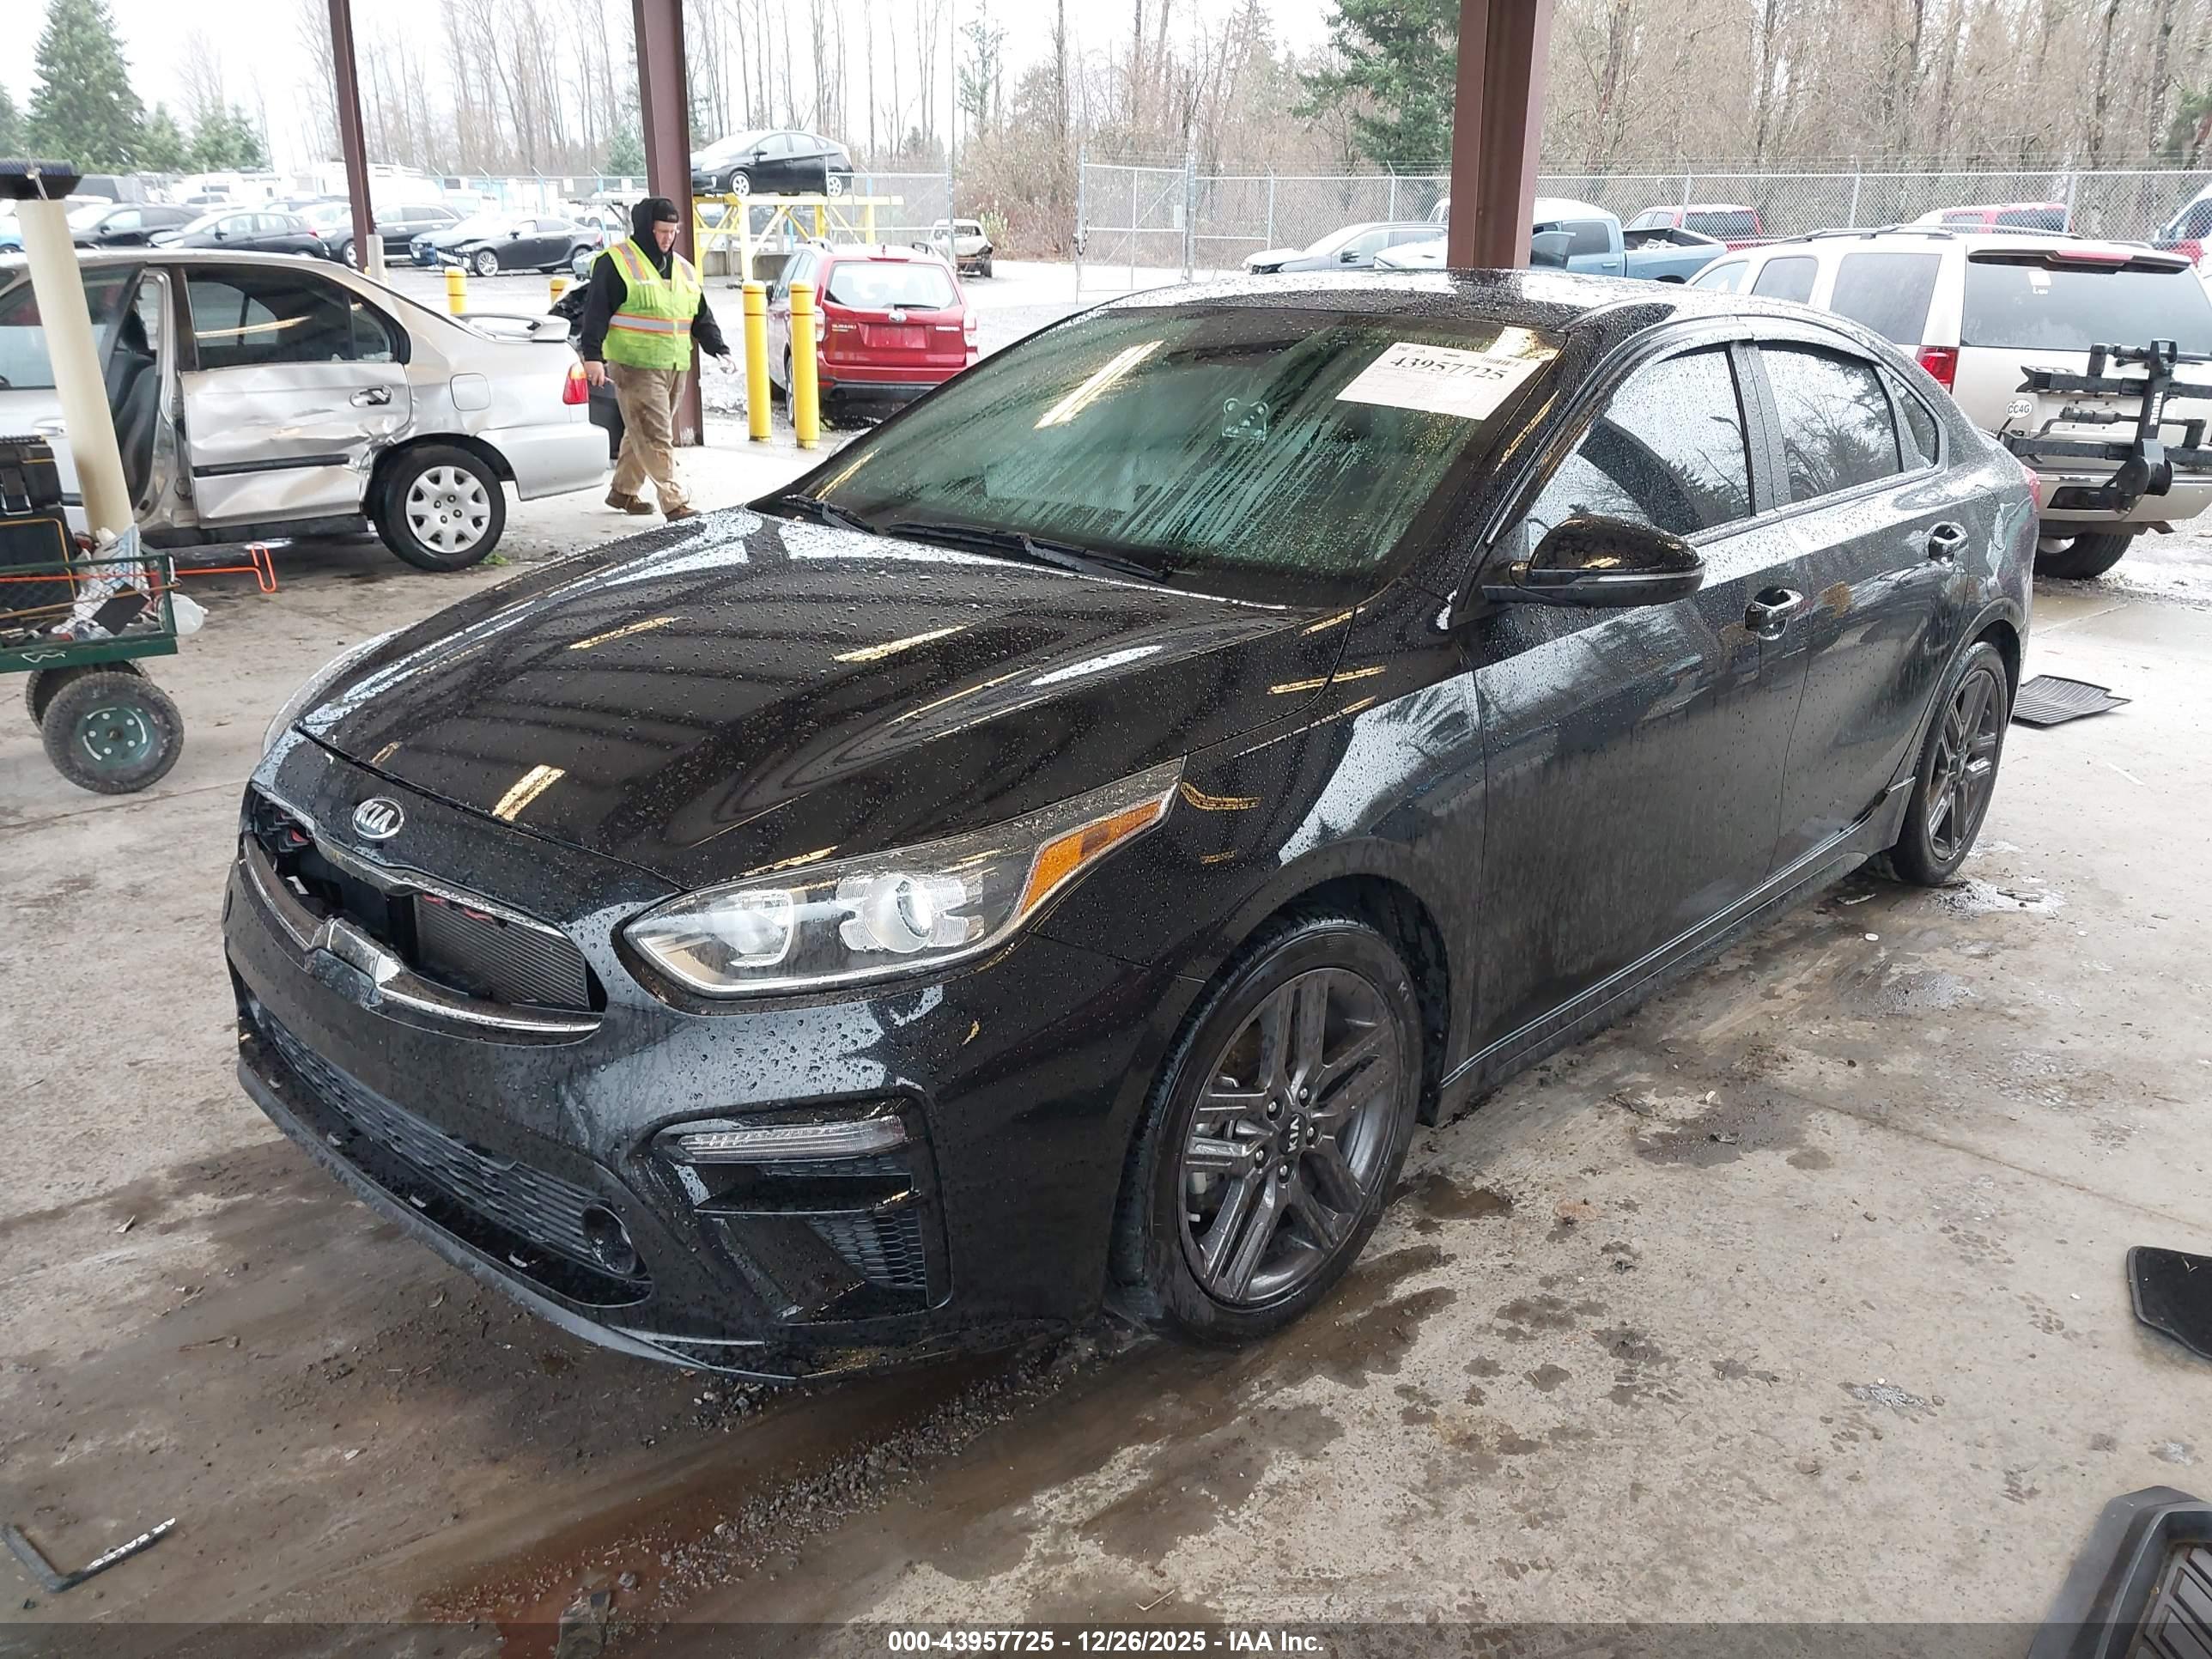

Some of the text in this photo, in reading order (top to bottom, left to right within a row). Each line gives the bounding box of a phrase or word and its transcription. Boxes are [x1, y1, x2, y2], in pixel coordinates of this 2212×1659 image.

[1390, 357, 1509, 380] 43957725
[2149, 392, 2163, 426] THULE
[355, 800, 395, 833] KIA
[1288, 1117, 1299, 1152] KIA
